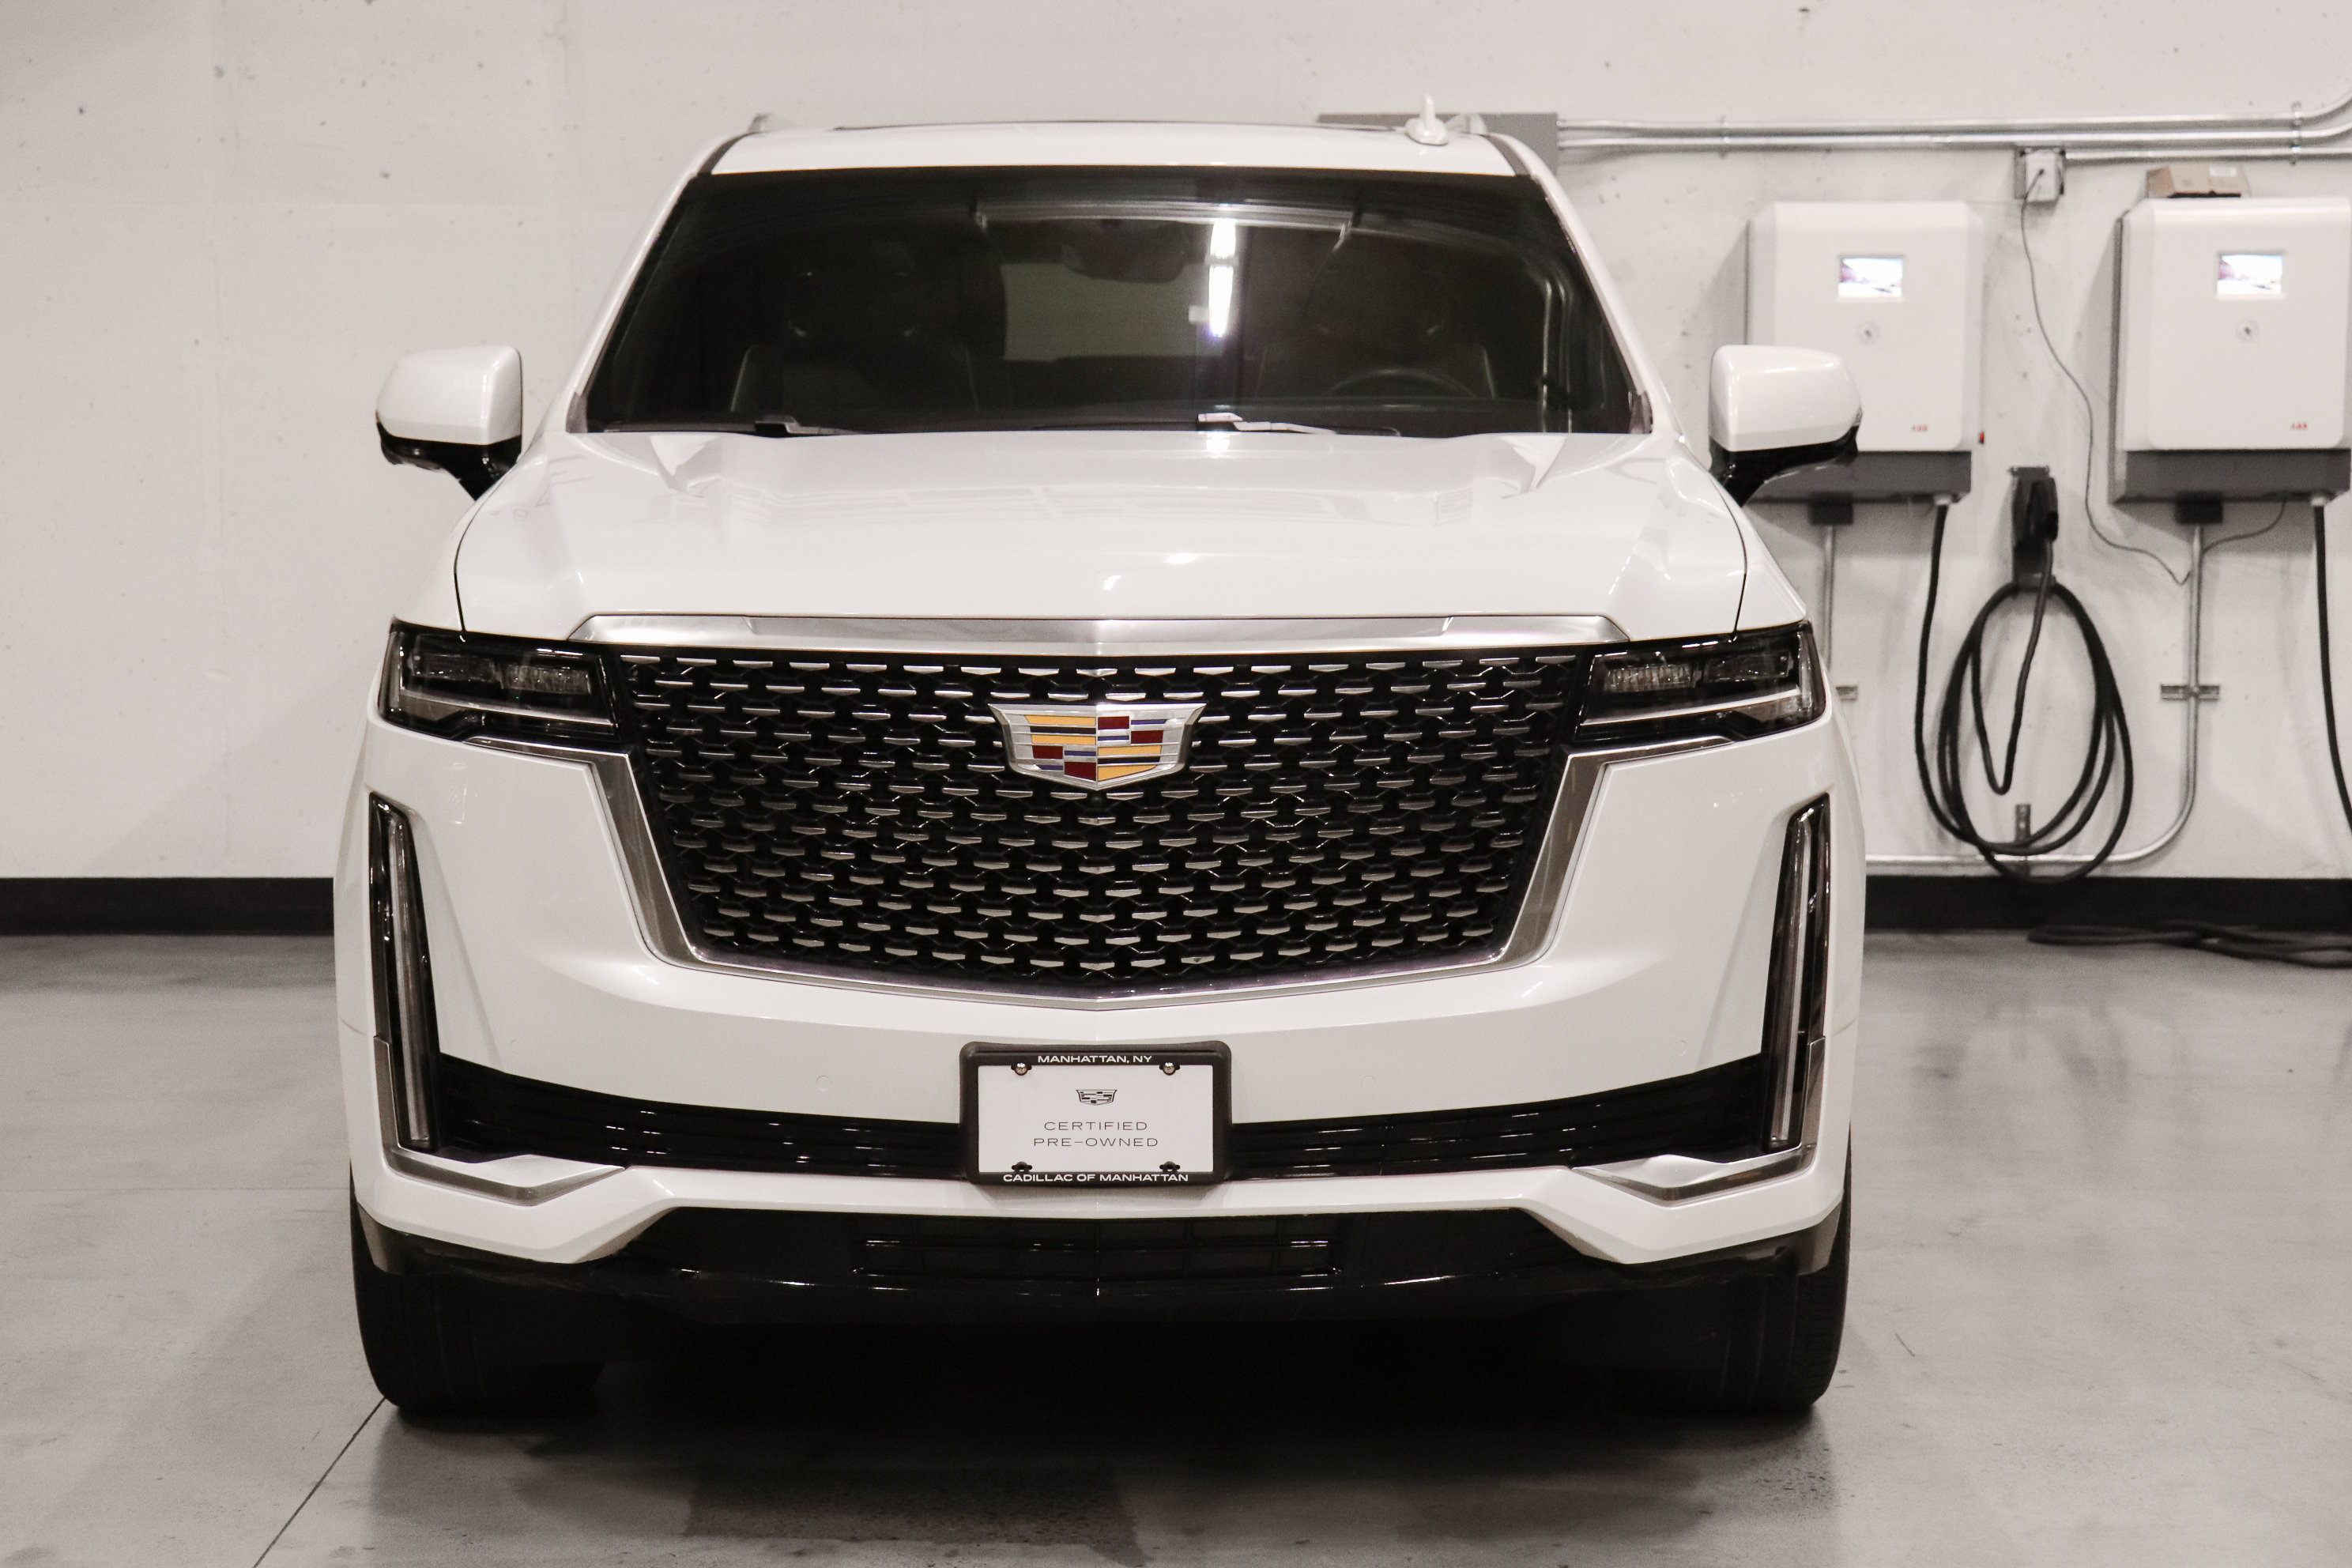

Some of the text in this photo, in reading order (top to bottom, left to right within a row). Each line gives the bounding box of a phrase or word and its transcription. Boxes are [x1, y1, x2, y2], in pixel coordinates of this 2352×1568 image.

[1038, 1055, 1130, 1064] MANHATTAN,
[1043, 1121, 1148, 1131] CERTIFIED
[1034, 1137, 1159, 1148] PRE-OWNED
[1003, 1174, 1189, 1182] CADILLAC OF MANHATTAN
